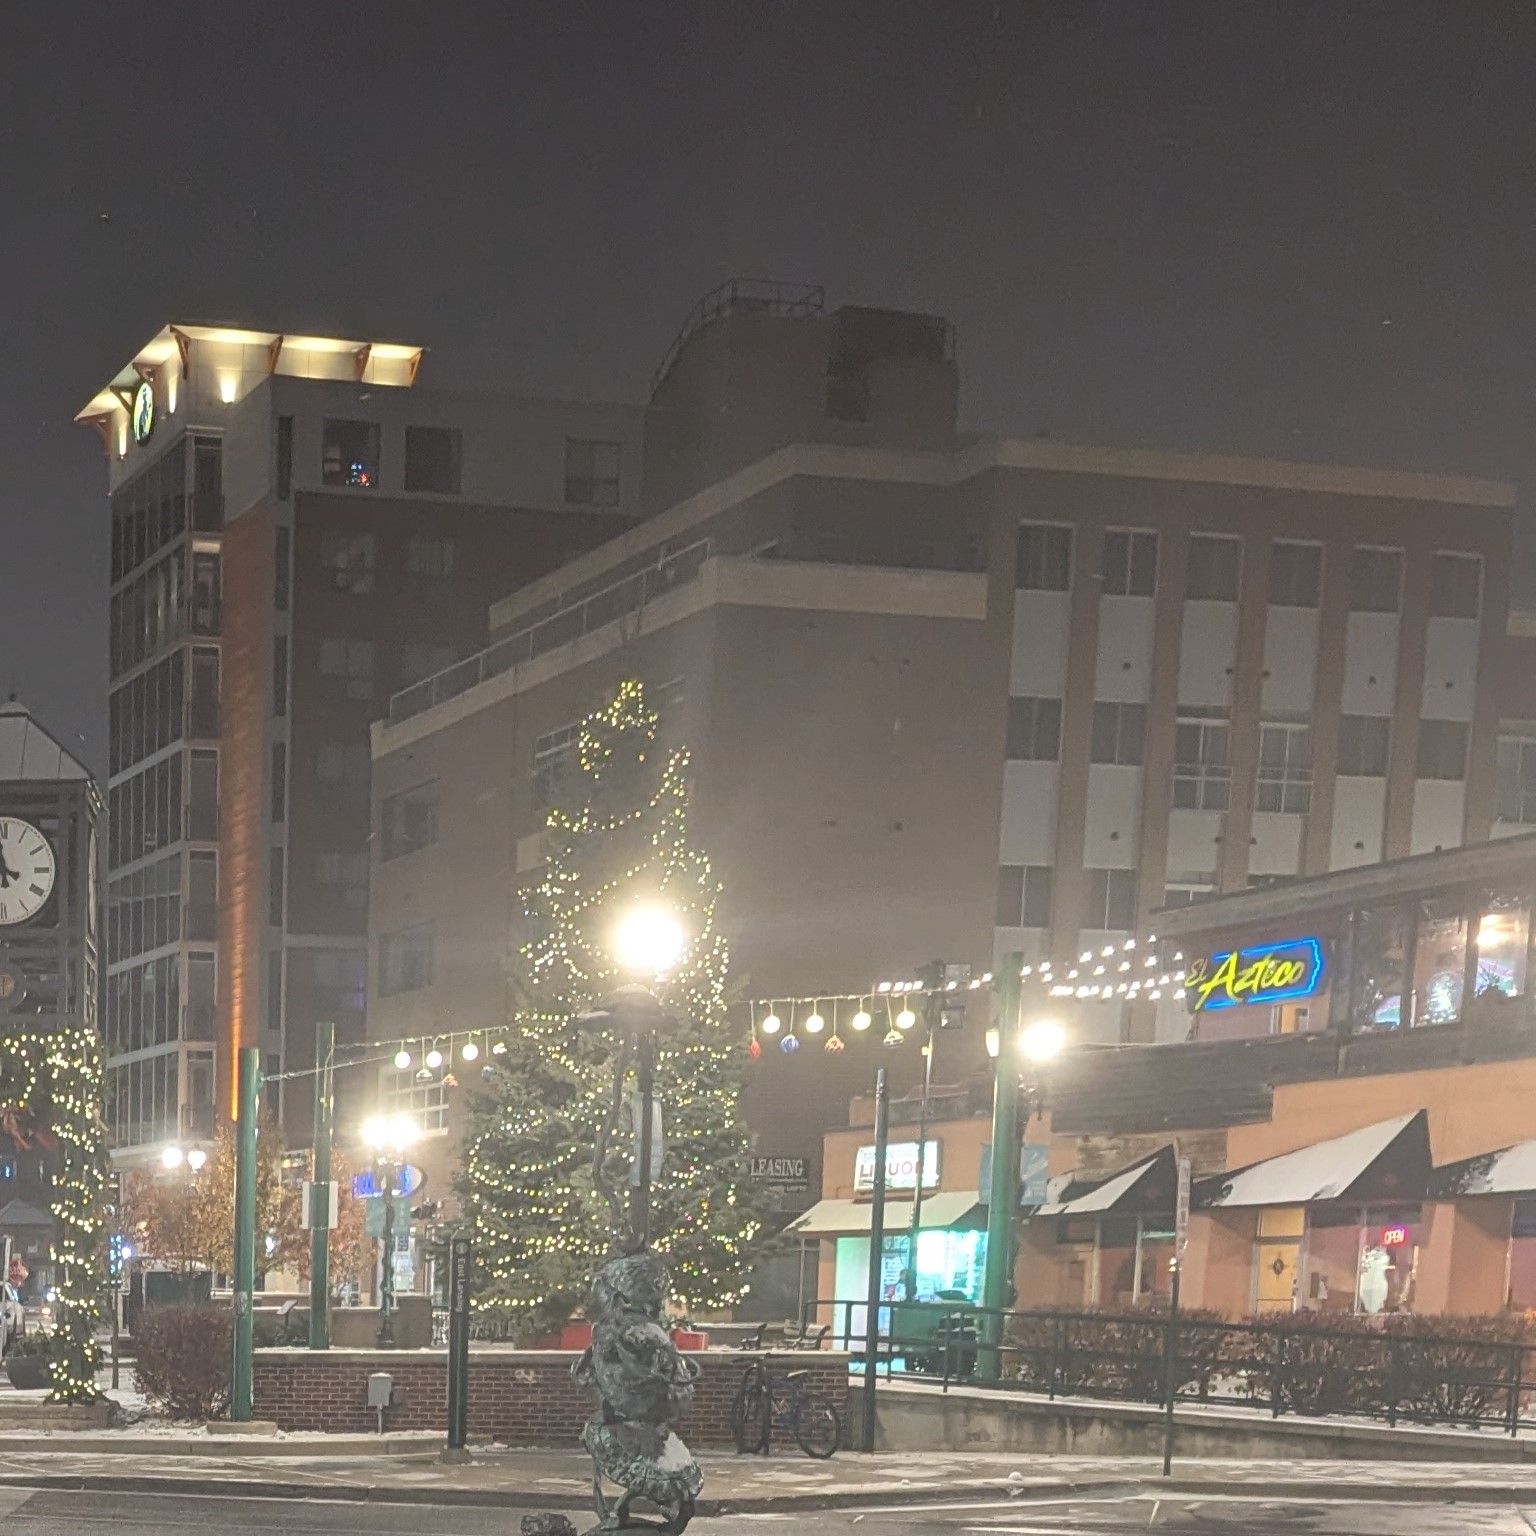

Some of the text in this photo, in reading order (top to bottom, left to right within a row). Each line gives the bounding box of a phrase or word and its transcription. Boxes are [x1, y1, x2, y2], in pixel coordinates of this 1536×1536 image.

[1184, 951, 1305, 1010] El Azteco
[750, 1158, 803, 1176] LEASING
[859, 1161, 920, 1178] LIUO
